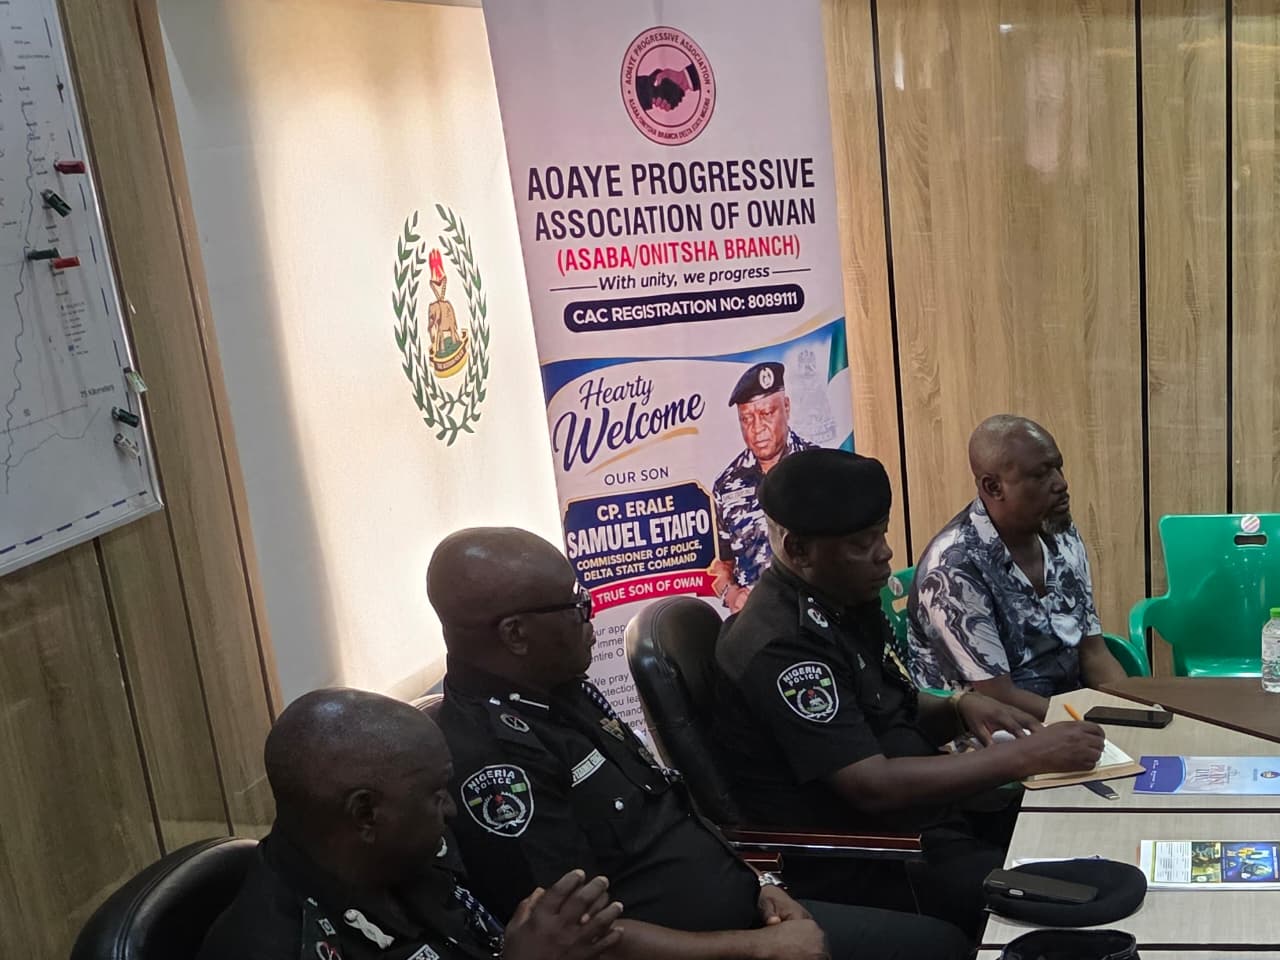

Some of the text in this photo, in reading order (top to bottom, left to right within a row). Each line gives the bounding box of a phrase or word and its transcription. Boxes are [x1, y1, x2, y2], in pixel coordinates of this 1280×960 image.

[634, 32, 680, 56] PROGRESSIVE
[680, 39, 711, 85] ASSOCIATION
[528, 157, 815, 201] AOAYE PROGRESSIVE
[535, 198, 816, 241] ASSOCIATION OF OWAN
[557, 234, 801, 277] (ASABA/ONITSHA BRANCH)
[598, 266, 770, 291] With unity, we progress
[573, 291, 797, 324] CAC REGISTRATION NO: 8089111
[578, 375, 654, 411] Hearty
[552, 393, 706, 472] Welcome
[604, 466, 669, 486] OUR SON
[596, 495, 675, 521] CP. ERALE
[566, 508, 710, 560] SAMUEL ETAIFO
[576, 549, 653, 571] COMMISSIONER
[656, 545, 669, 557] OF
[584, 552, 698, 582] DELTA STATE COMMAND
[596, 576, 704, 605] TRUE SON OF OWAN
[591, 651, 613, 662] ntire
[608, 670, 629, 685] pray
[782, 665, 823, 683] NIGERIA
[788, 673, 820, 687] POLICE
[467, 769, 516, 791] NIGERIA
[474, 777, 512, 794] POLICE
